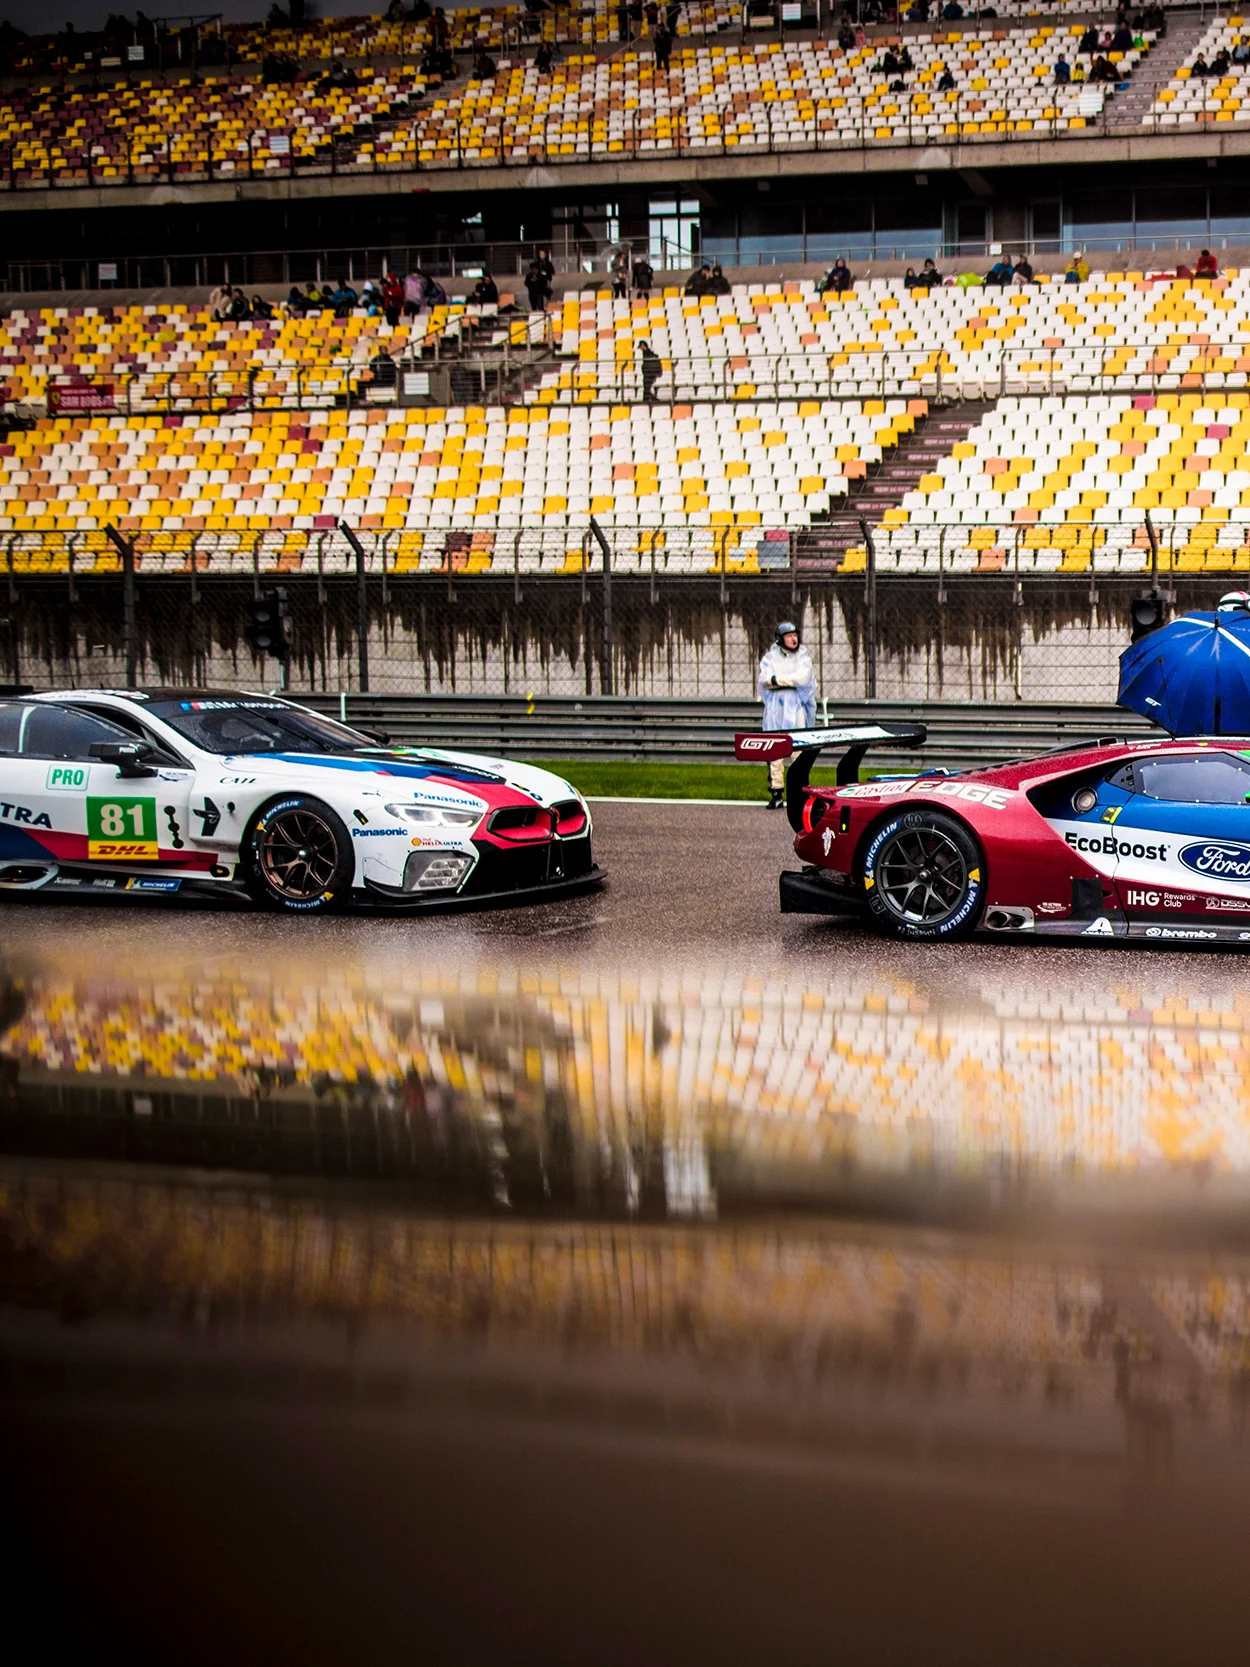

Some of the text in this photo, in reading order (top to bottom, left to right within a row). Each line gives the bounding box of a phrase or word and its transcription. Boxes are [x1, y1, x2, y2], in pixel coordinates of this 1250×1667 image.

[740, 738, 786, 751] GT
[52, 769, 84, 785] PRO
[413, 792, 483, 808] Panasonic
[854, 780, 1015, 810] Castrol EDGE
[1, 802, 52, 829] TRA
[266, 801, 299, 818] MICHELIN
[100, 803, 145, 837] 81
[352, 828, 408, 837] Panasonic
[97, 845, 149, 855] DHL
[866, 822, 897, 868] MICHELIN
[1065, 832, 1168, 861] EcoBoost
[1127, 890, 1160, 906] IHG
[940, 890, 976, 932] MICHELIN
[1161, 929, 1217, 939] brembo
